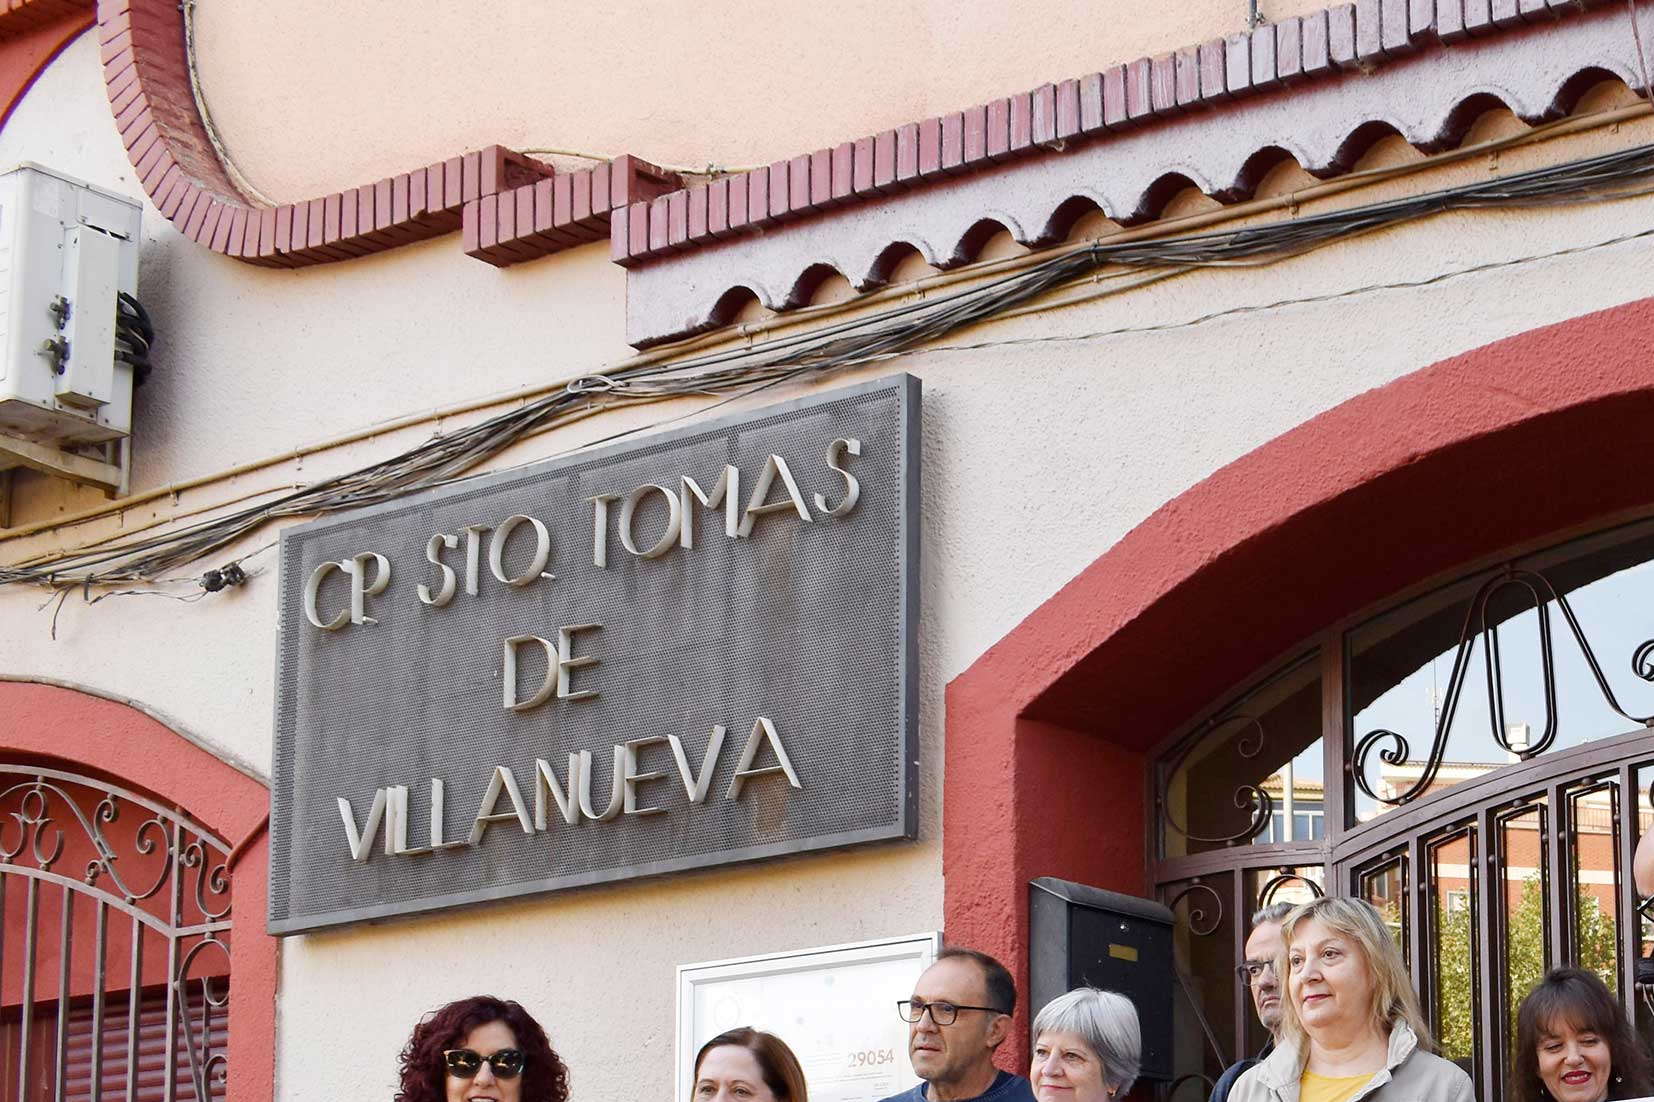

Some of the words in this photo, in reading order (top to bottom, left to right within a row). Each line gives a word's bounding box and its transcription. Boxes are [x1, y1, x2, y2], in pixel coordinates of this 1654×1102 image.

[587, 439, 861, 569] TOMAS
[503, 622, 604, 712] DE
[337, 716, 802, 862] VILLANUEVA
[848, 1048, 894, 1068] 29054
